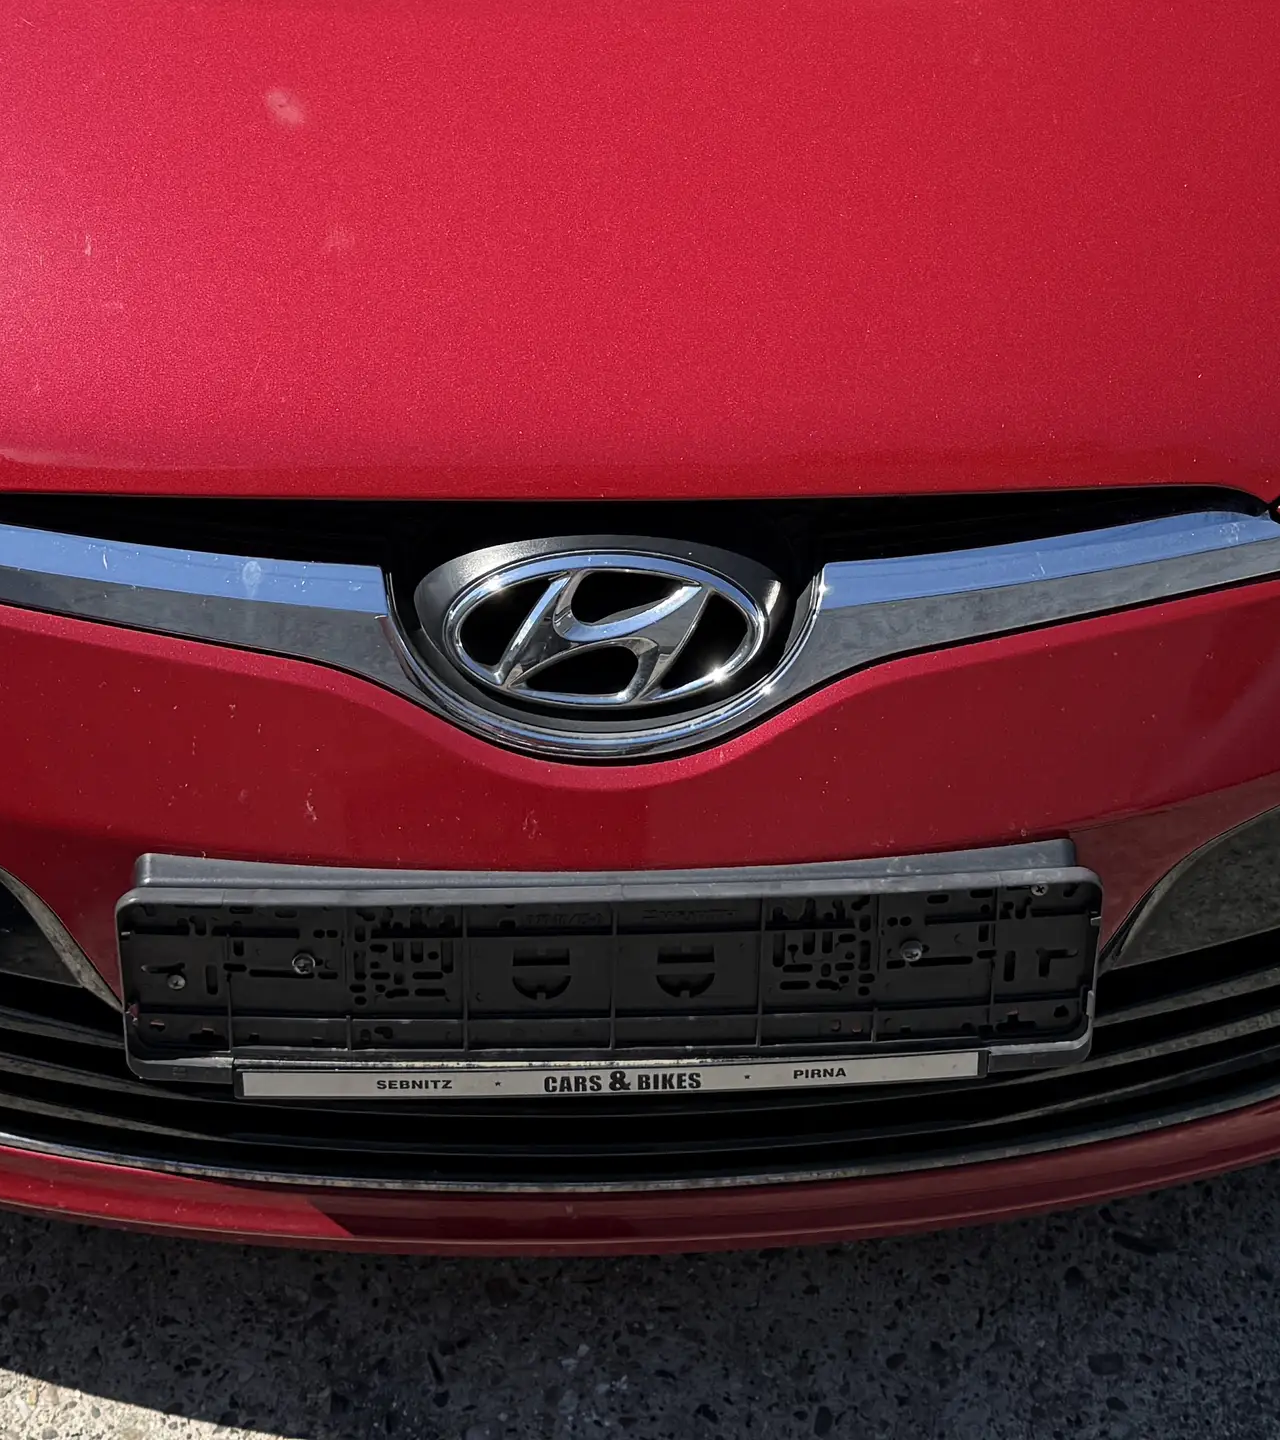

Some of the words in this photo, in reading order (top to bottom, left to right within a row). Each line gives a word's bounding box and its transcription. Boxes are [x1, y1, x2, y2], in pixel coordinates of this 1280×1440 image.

[376, 1079, 453, 1090] SEBNITZ
[544, 1075, 602, 1093] CARS
[608, 1069, 631, 1091] &
[637, 1072, 702, 1090] BIKES
[793, 1067, 847, 1080] PIRNA
